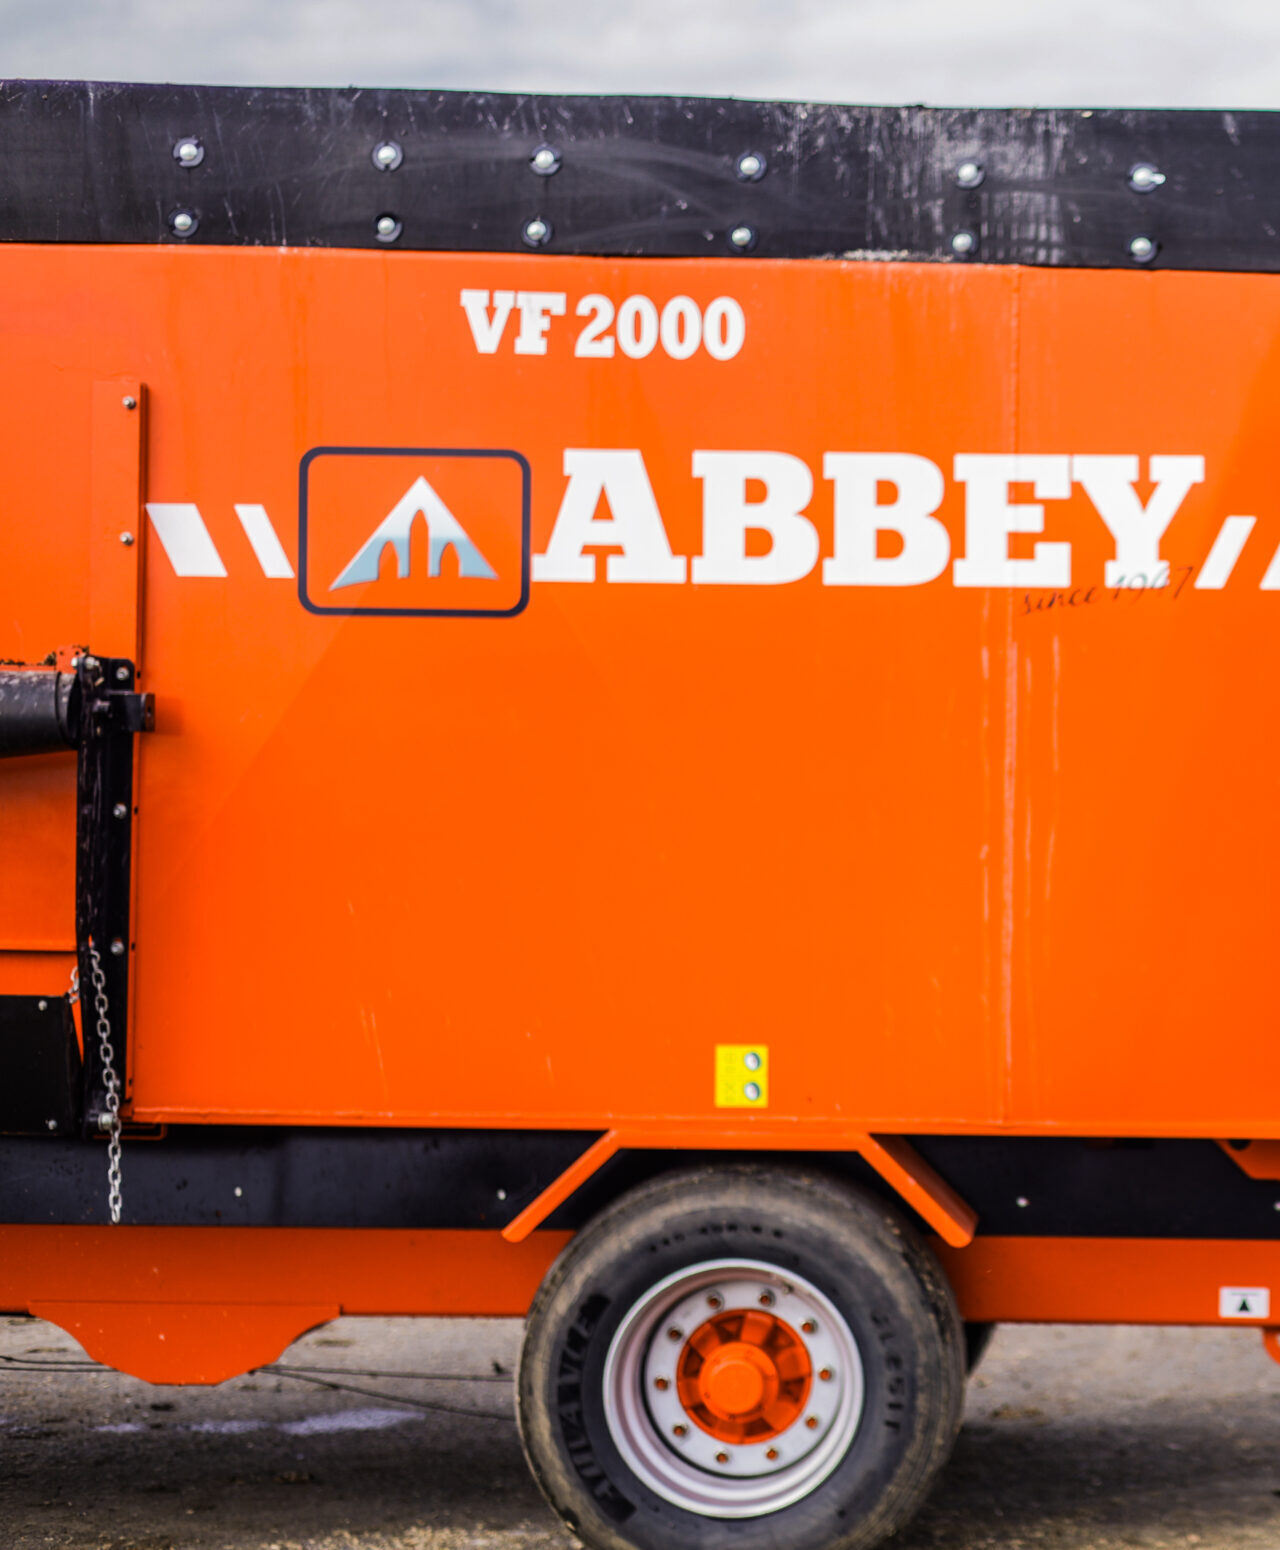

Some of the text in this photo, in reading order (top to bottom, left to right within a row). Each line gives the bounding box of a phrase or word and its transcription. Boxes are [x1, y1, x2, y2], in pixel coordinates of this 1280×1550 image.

[460, 289, 746, 361] VF 2000
[532, 448, 1204, 588] ABBEY
[1020, 586, 1098, 616] since
